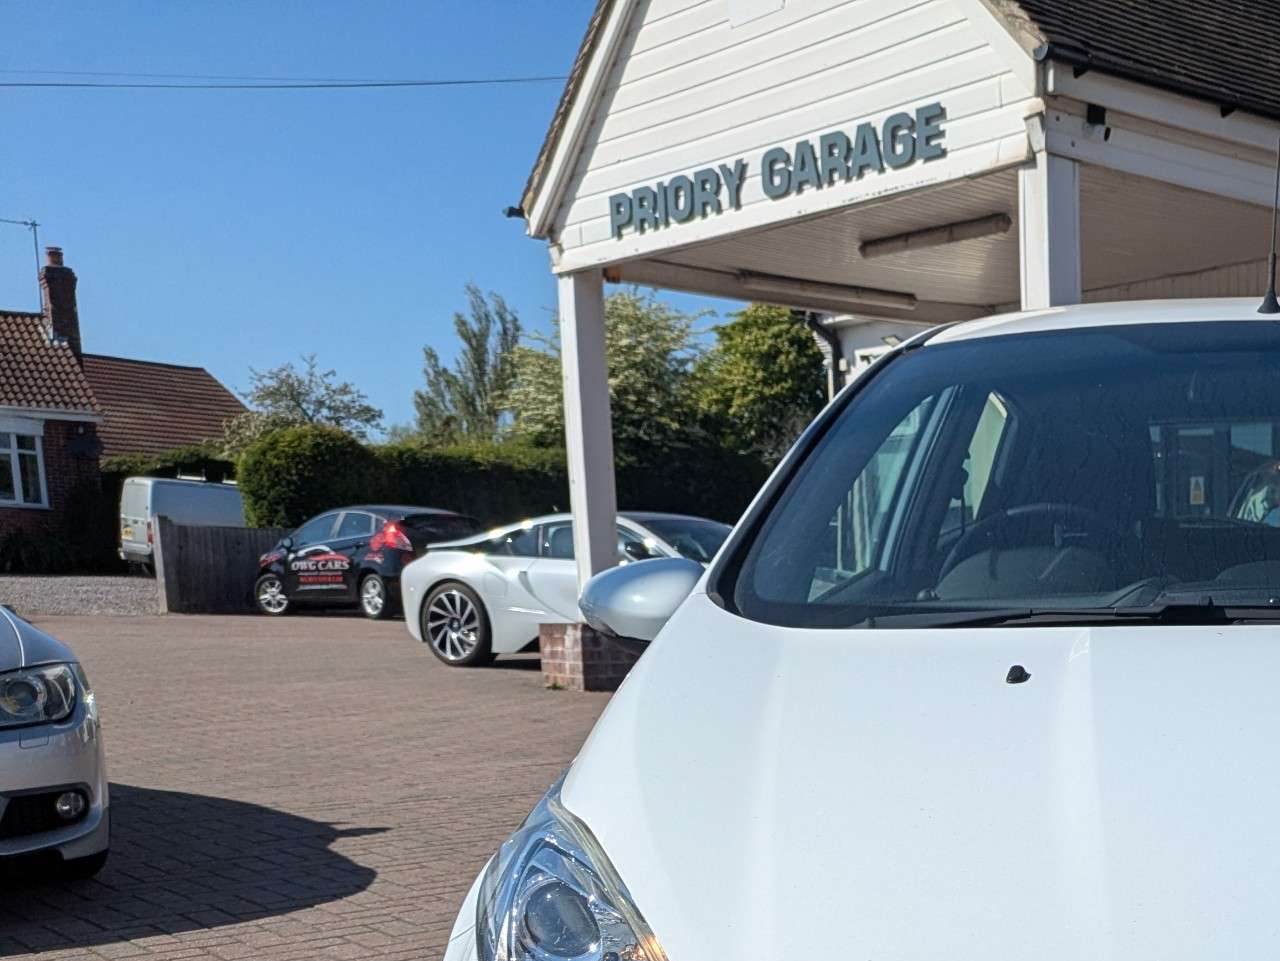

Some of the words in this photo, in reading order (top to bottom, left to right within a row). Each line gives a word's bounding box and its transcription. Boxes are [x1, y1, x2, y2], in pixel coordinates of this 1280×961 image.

[608, 158, 748, 239] PRIORY
[760, 101, 948, 200] GARAGE
[291, 561, 316, 571] OWG
[317, 560, 350, 570] CARS
